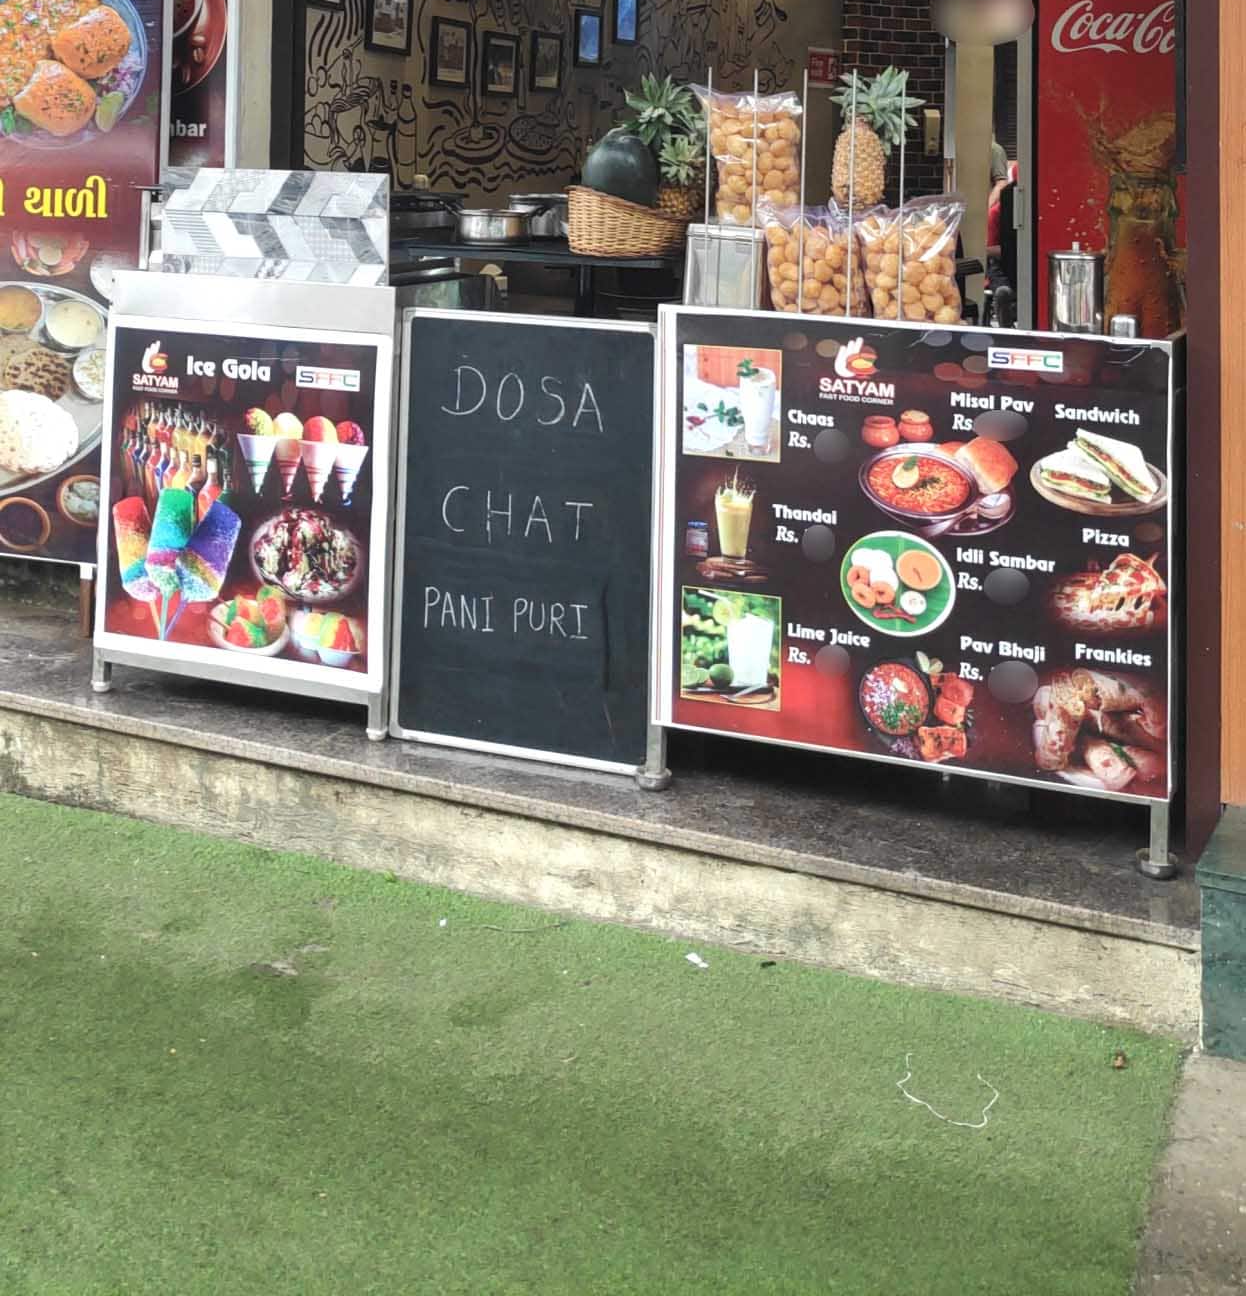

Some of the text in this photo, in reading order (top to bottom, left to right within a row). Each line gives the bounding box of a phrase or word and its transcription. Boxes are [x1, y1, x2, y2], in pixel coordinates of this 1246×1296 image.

[23, 175, 108, 219] થાળી
[186, 355, 272, 383] Ice Gola
[991, 352, 1061, 369] SFFC
[132, 373, 179, 389] SATYAM
[298, 370, 358, 388] SFFC
[819, 377, 895, 398] SATYAM
[441, 365, 604, 433] DOSA
[838, 394, 861, 403] FOOD
[950, 391, 1034, 413] Misal Pav
[788, 409, 834, 428] Chaas
[1055, 404, 1140, 426] Sandwich
[442, 486, 594, 544] CHAT
[773, 504, 837, 526] Thandai
[1082, 528, 1130, 547] Pizza
[956, 547, 1056, 574] Idli Sambar
[424, 586, 588, 640] PANI PURI
[787, 623, 870, 648] Lime Juice
[960, 636, 1045, 663] Pav Bhaji
[1074, 643, 1152, 667] Frankies
